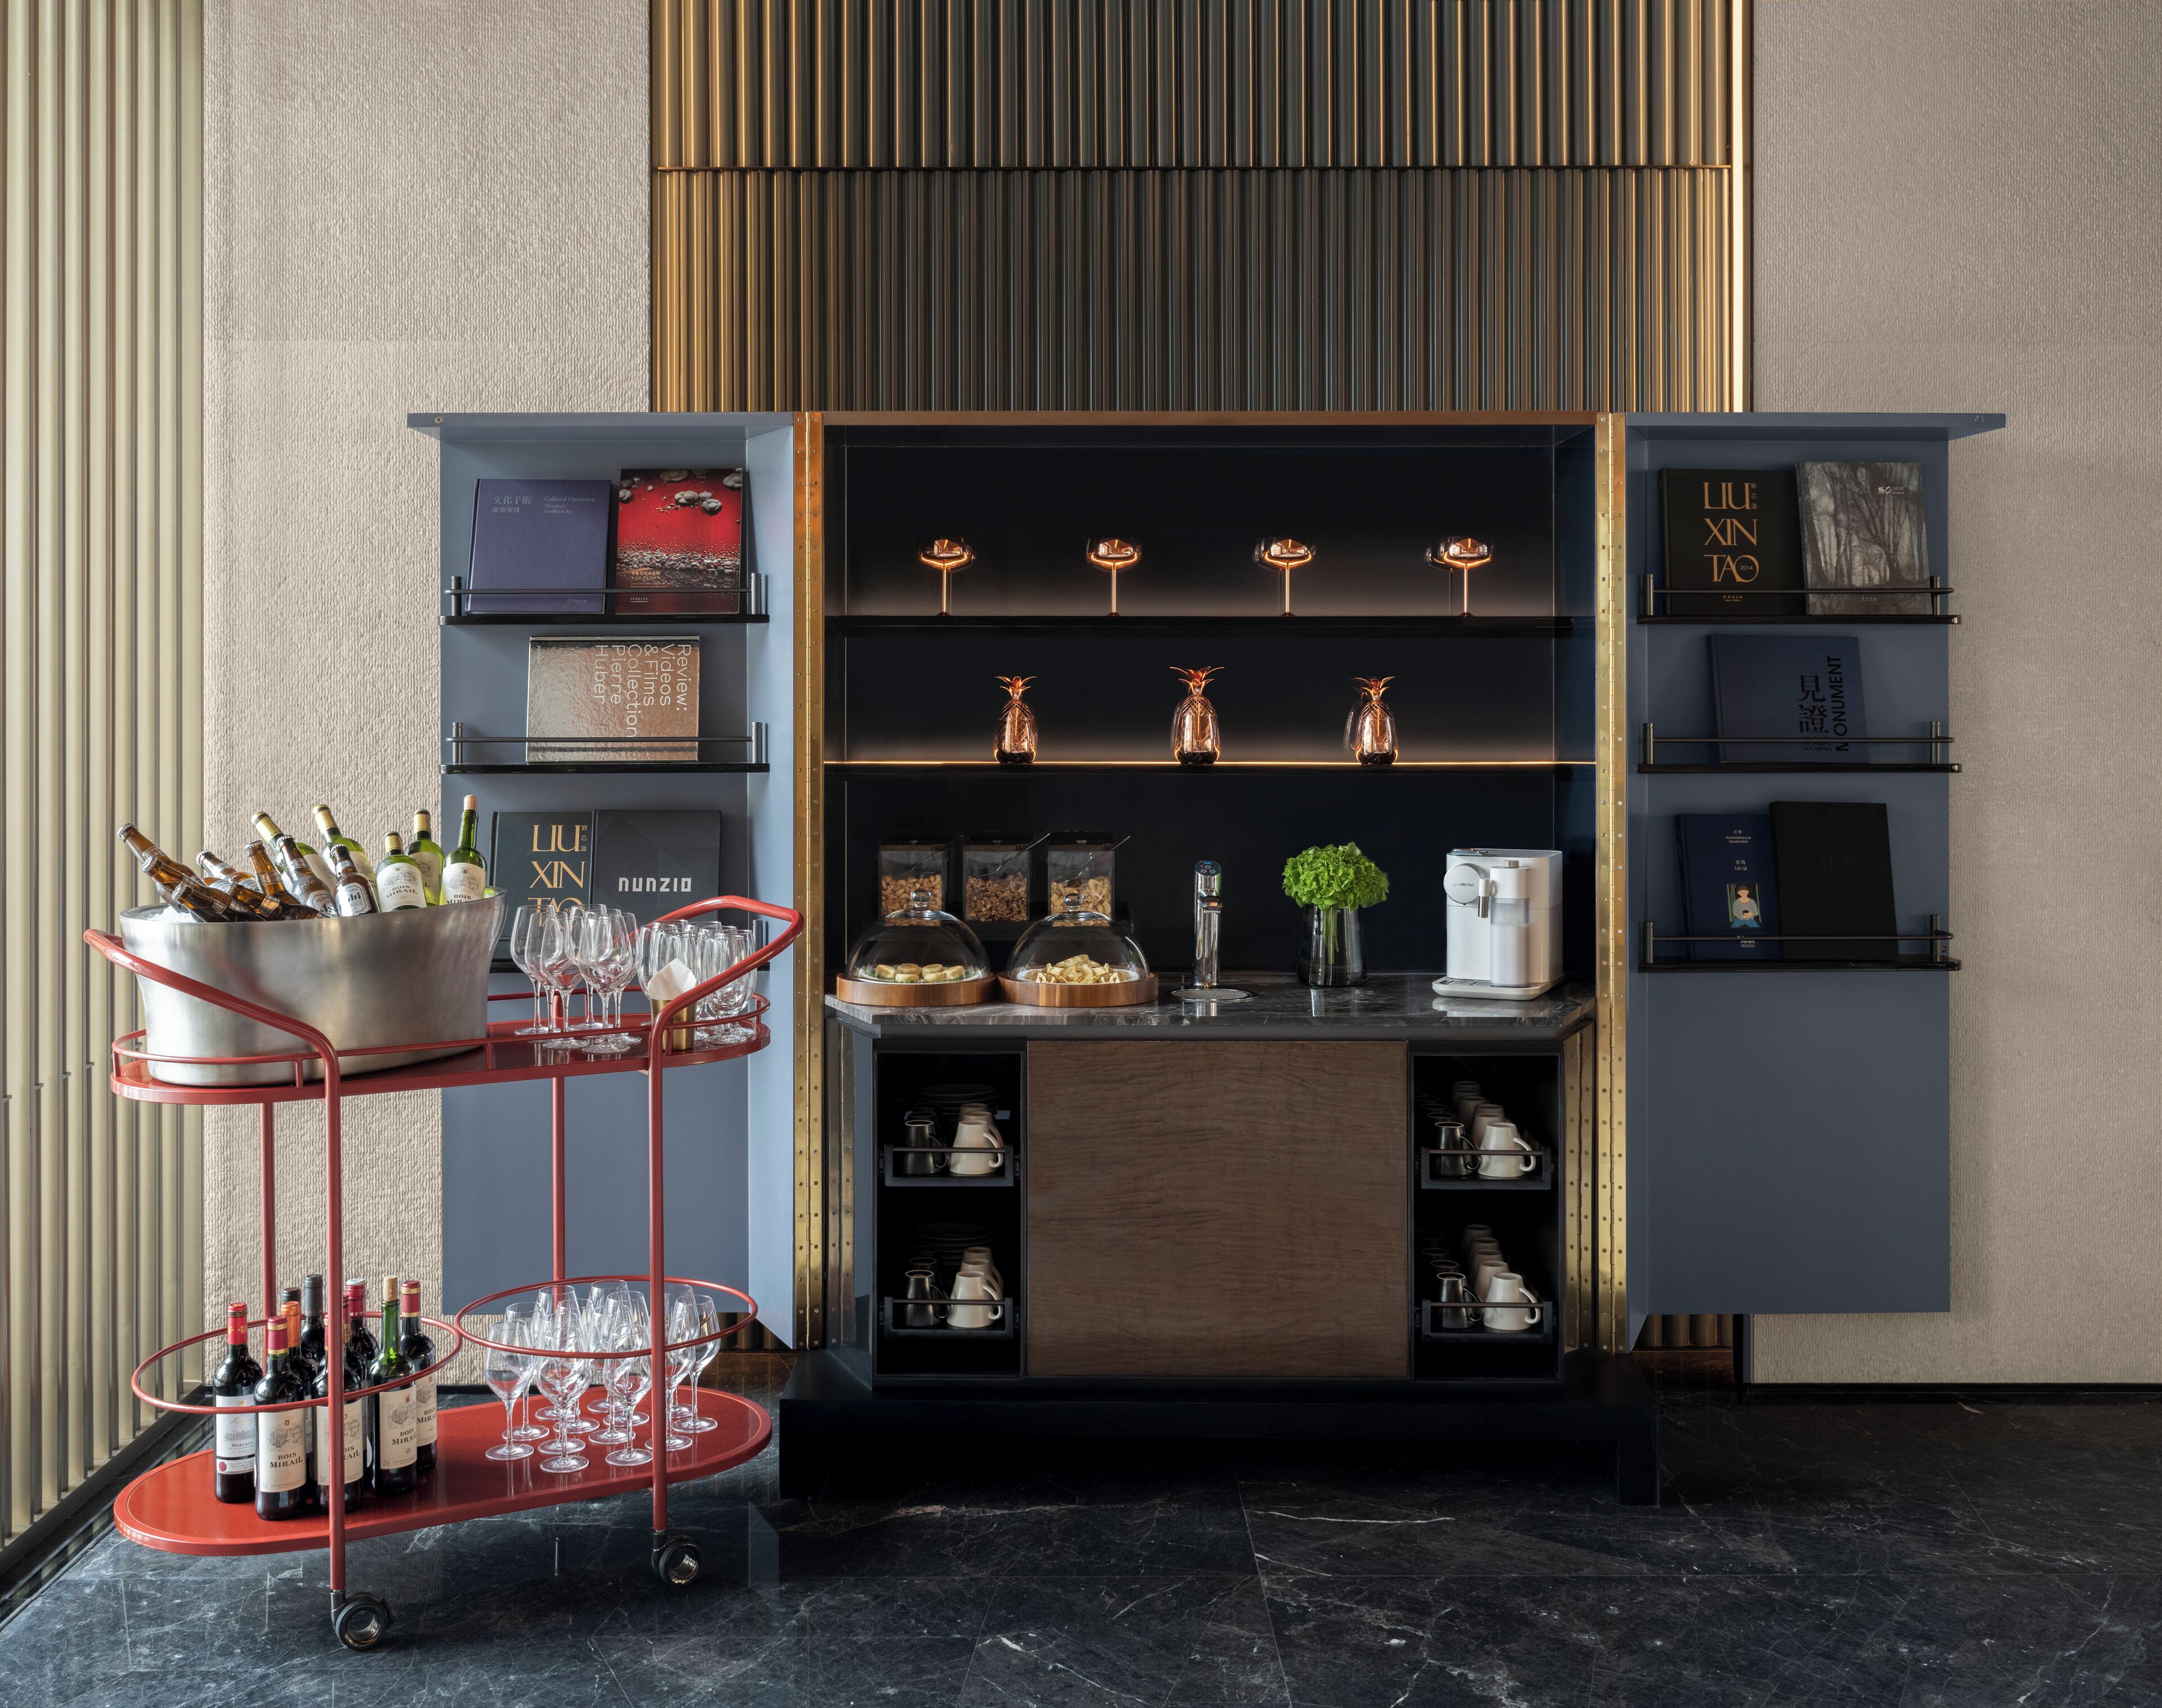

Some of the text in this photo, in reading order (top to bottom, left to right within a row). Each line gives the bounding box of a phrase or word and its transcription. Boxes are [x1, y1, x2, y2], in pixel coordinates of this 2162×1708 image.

[492, 495, 531, 505] 文化手術
[1703, 482, 1751, 509] LIU
[1704, 518, 1758, 546] XIN
[1704, 554, 1759, 583] TAO
[594, 645, 609, 705] Huber
[610, 645, 626, 705] Pierre
[644, 644, 658, 706] & Films
[660, 643, 674, 706] Videos
[676, 644, 691, 711] Review:
[626, 644, 642, 737] Collection
[1797, 674, 1829, 733] 見證
[531, 825, 582, 852] LIU
[529, 861, 586, 888] XIN
[386, 888, 418, 900] MIRAIL
[400, 1428, 414, 1437] BOIS
[270, 1456, 303, 1469] MIRAIL
[278, 1452, 297, 1461] BOIS
